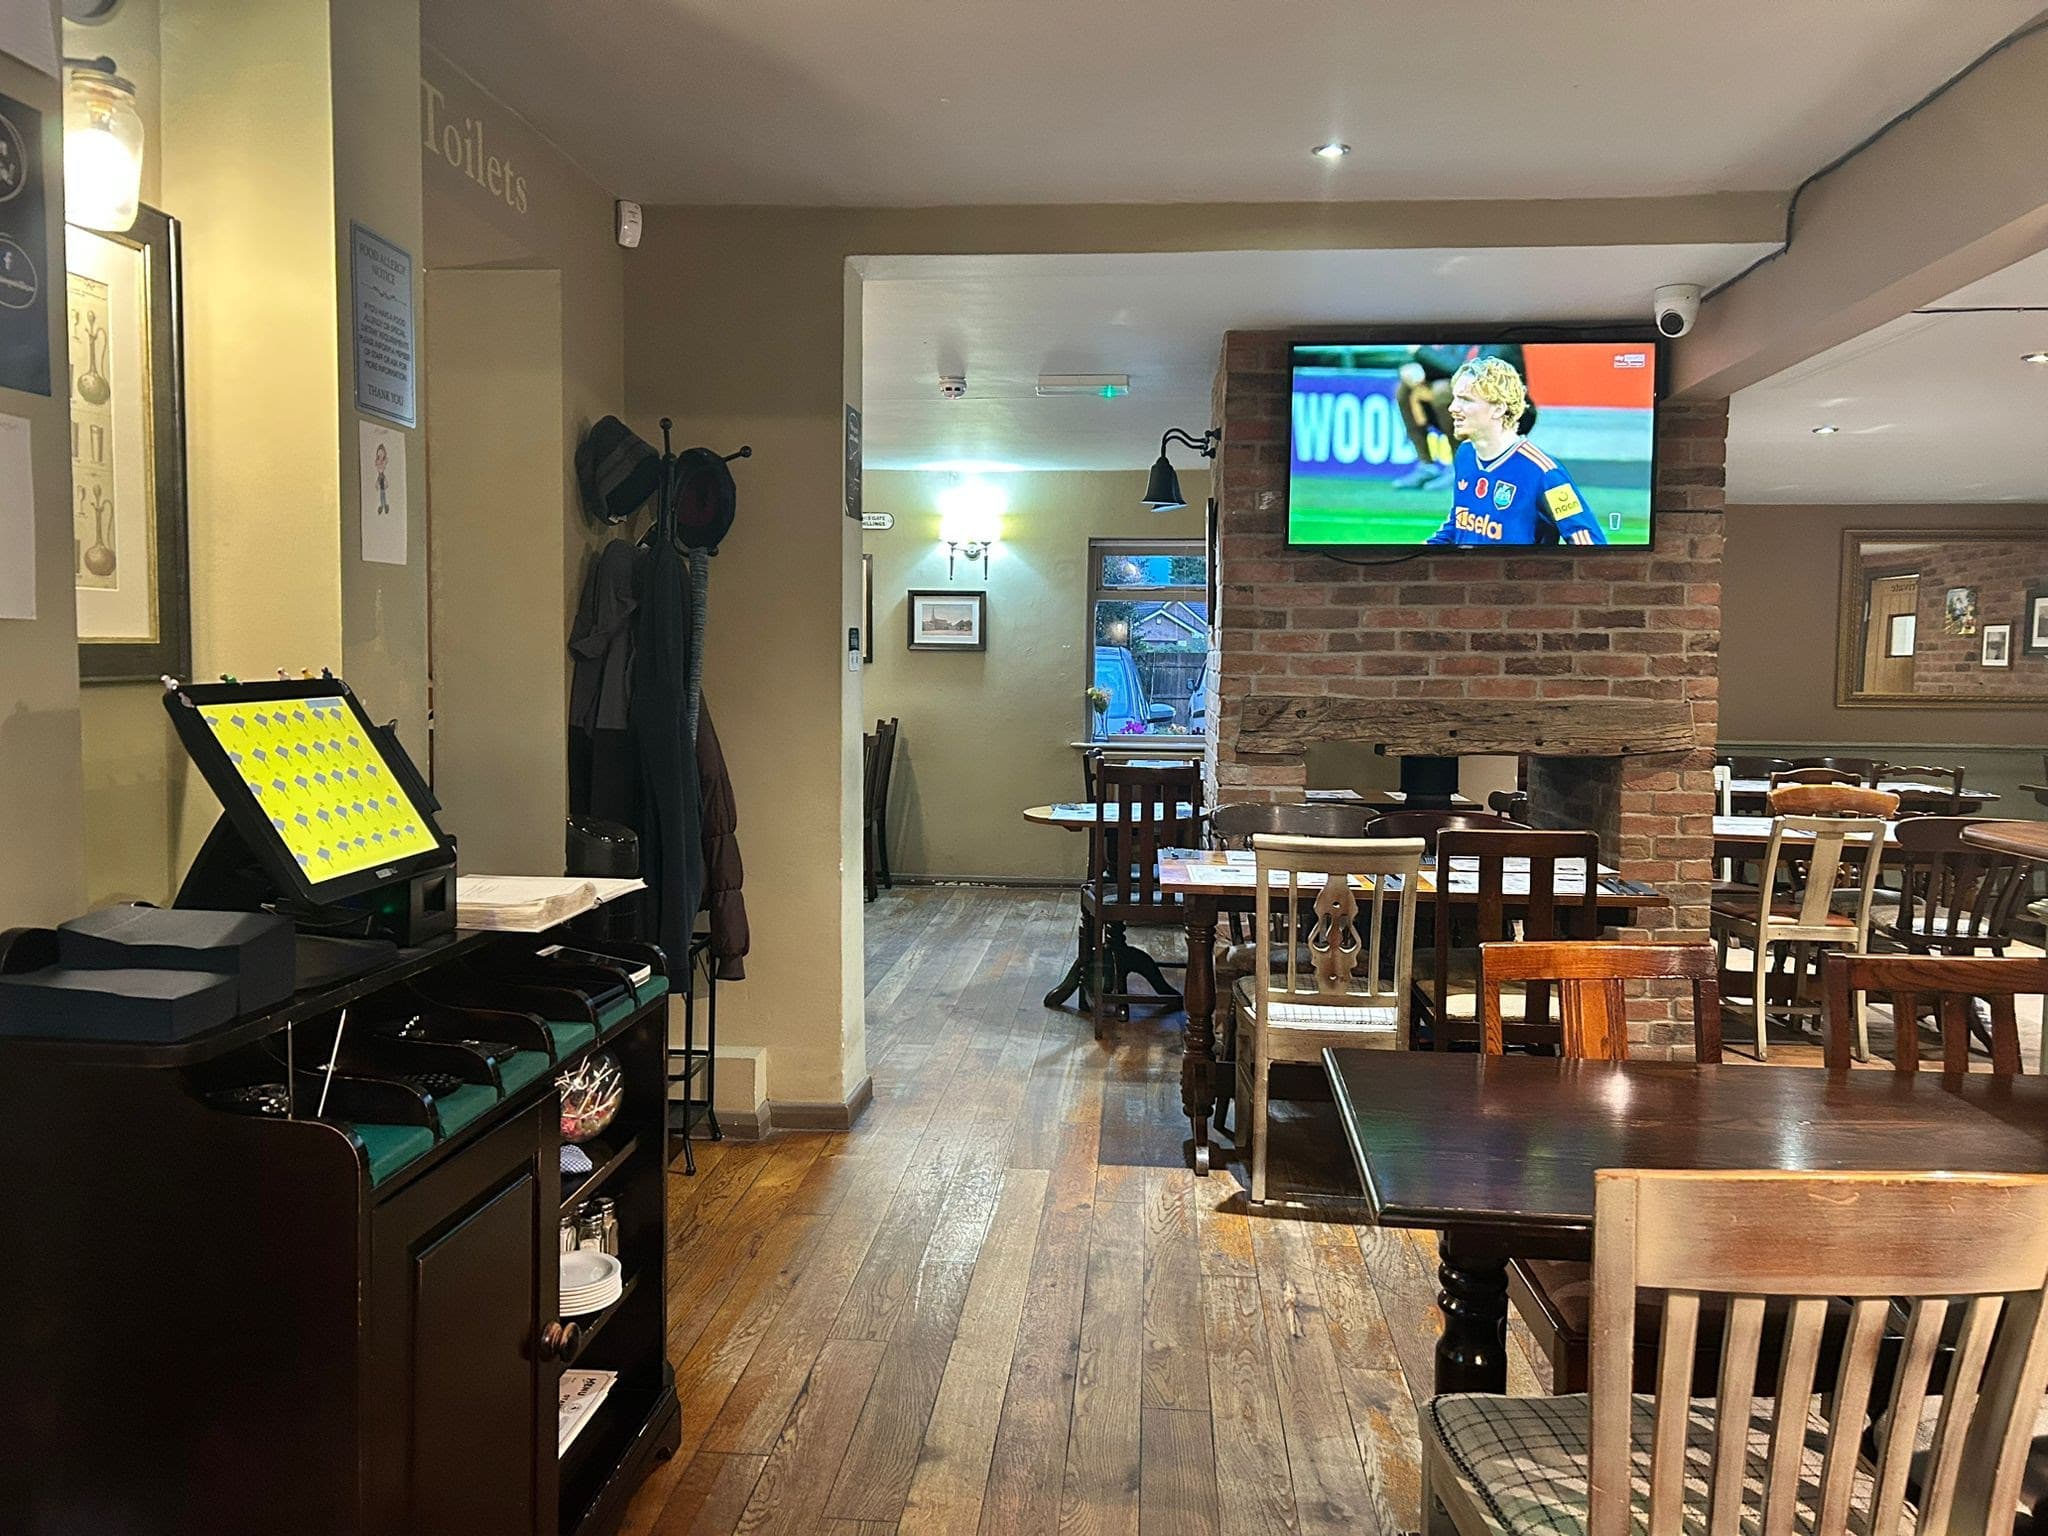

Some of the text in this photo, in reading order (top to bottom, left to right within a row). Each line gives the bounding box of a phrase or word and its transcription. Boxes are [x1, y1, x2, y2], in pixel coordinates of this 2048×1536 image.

[421, 78, 527, 214] Toilets
[371, 262, 395, 286] NOTICE
[367, 382, 404, 407] THANK YOU
[1555, 501, 1578, 514] noon
[1467, 513, 1503, 539] sela
[577, 1377, 597, 1396] MENU
